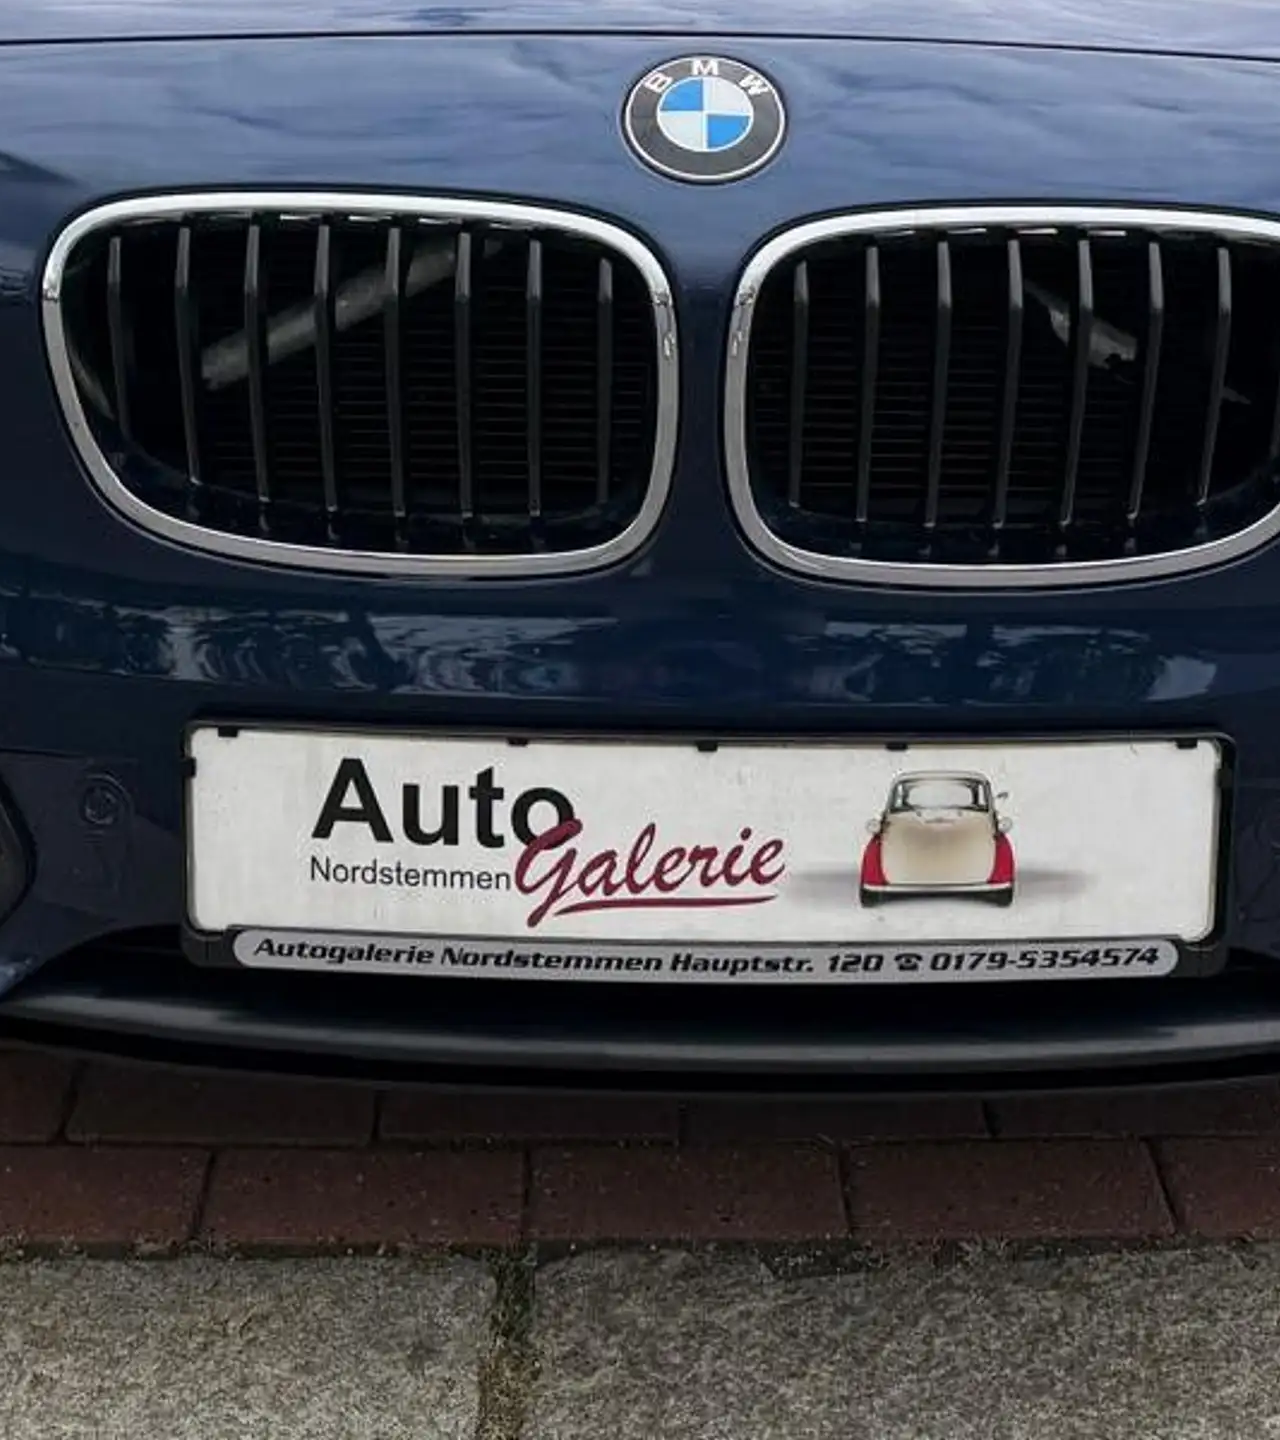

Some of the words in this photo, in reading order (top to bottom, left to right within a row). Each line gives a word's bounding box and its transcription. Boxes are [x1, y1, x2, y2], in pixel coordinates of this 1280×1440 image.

[644, 58, 770, 96] BMW
[311, 756, 575, 850] Auto
[310, 855, 512, 892] Nordstemmen
[515, 817, 786, 928] Galerie
[252, 937, 433, 965] Autogalerie
[440, 946, 662, 972] Nordstemmen
[669, 952, 814, 977] Hauptstr.
[827, 953, 884, 974] 120
[930, 947, 1160, 972] 0179-5354574
